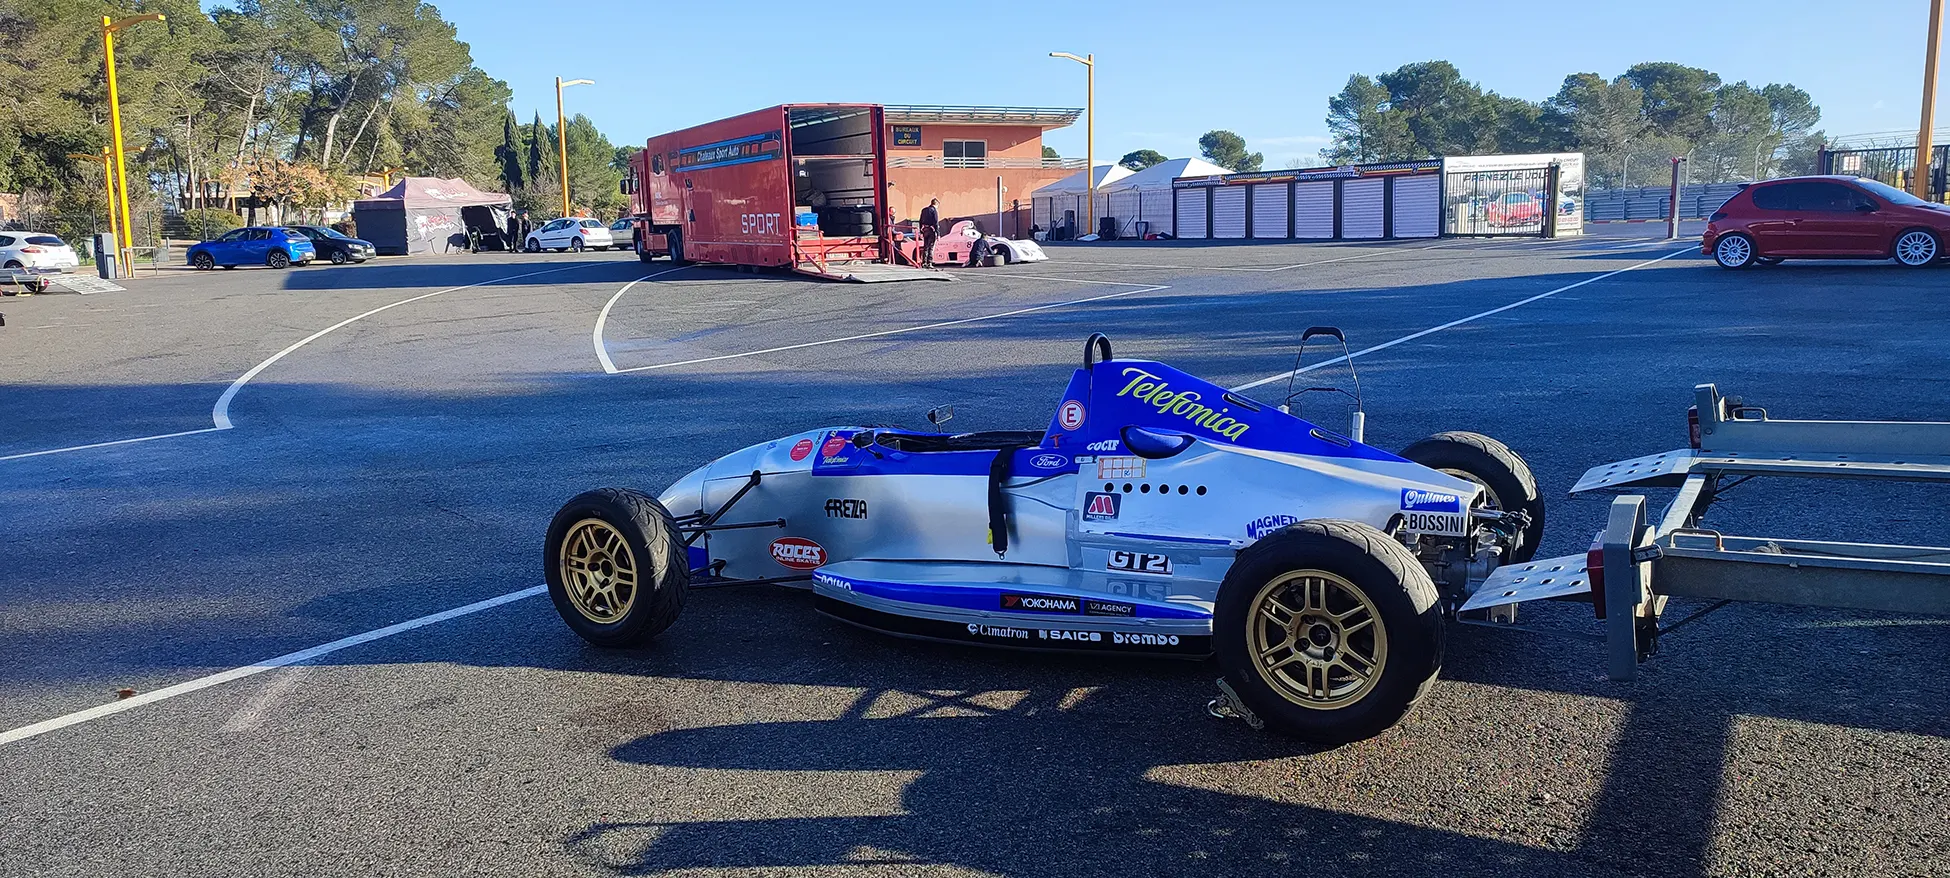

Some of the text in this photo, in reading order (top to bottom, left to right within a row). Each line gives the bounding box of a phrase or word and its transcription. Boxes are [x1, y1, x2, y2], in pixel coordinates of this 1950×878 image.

[716, 147, 728, 161] Sport
[728, 145, 740, 157] Auto
[741, 213, 780, 234] SPORT
[1116, 367, 1250, 442] Telefonica
[1066, 407, 1077, 423] E
[1036, 455, 1061, 467] Ford
[1410, 513, 1464, 533] BOSSINI
[773, 543, 820, 560] ROCES
[1021, 598, 1076, 610] YOKOHAMA
[1101, 604, 1131, 613] AGENCY
[979, 624, 1029, 639] Cimatron
[1050, 630, 1101, 642] SAICO
[1113, 632, 1180, 645] brembo
